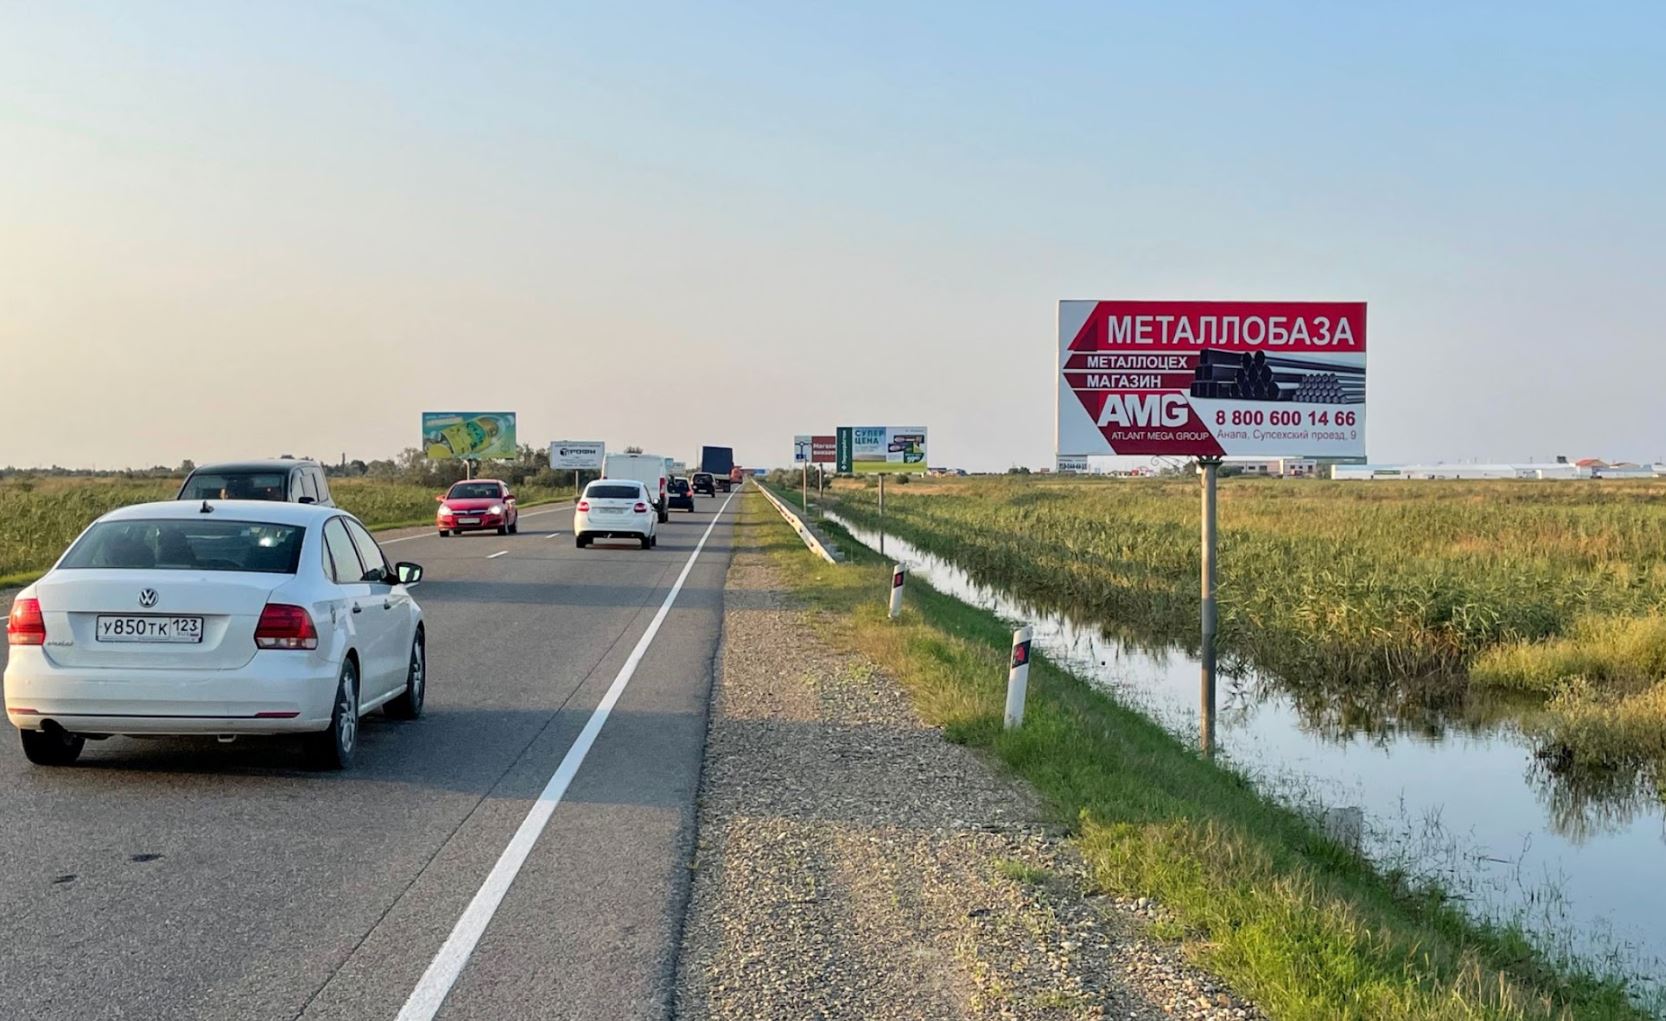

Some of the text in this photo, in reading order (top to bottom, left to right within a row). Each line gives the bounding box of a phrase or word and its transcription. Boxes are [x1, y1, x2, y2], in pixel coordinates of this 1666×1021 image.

[1107, 315, 1355, 346] МЕТАЛЛОБАЗА
[1087, 356, 1188, 371] МЕТАЛЛОЦЕХ
[1087, 375, 1162, 389] МАГАЗИН
[1097, 393, 1189, 427] AMG
[1215, 410, 1356, 426] 8 800 600 14 66
[854, 429, 884, 437] СУПЕР
[1111, 431, 1209, 440] ATLANT MEGA GROUP
[1253, 429, 1309, 441] Супсехский
[1350, 430, 1357, 439] 9
[854, 437, 879, 445] ЦЕНА
[173, 619, 198, 632] 123
